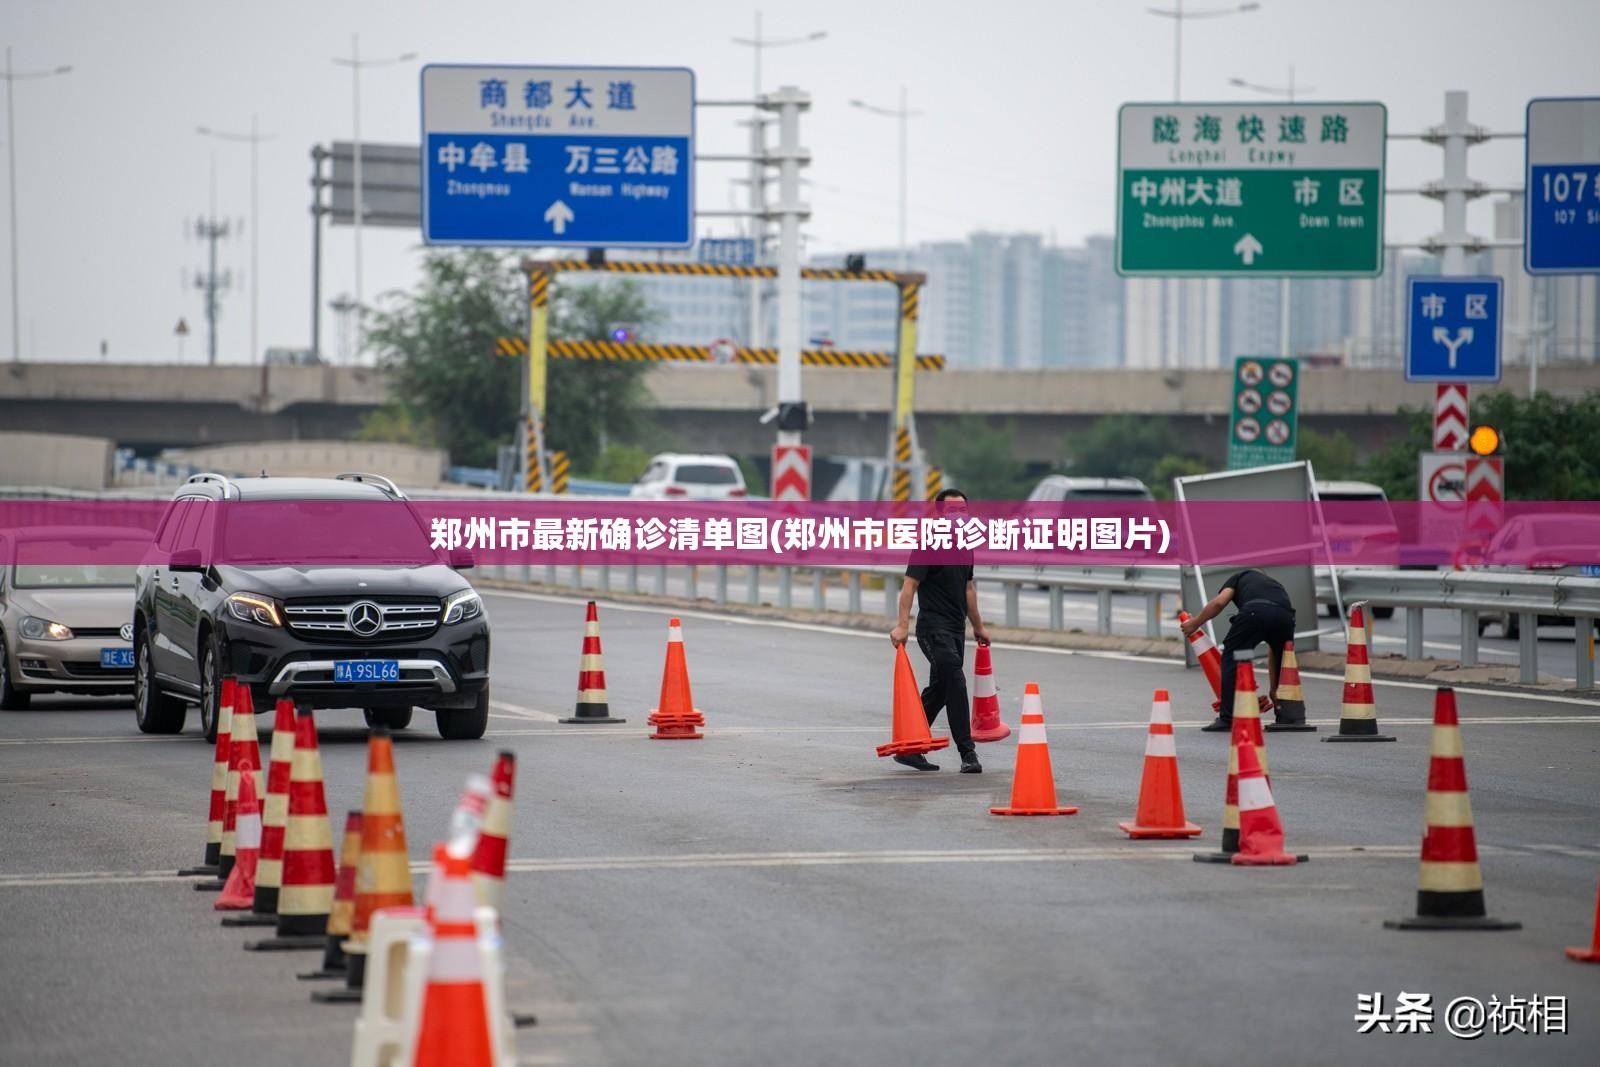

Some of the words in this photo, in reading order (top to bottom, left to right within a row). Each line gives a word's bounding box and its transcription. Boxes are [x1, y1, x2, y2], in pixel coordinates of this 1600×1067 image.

[479, 79, 636, 110] 商都大道
[1152, 114, 1349, 144] 陇海快速路
[438, 142, 531, 173] 中牟县
[565, 146, 678, 175] 万三公路
[1169, 148, 1226, 165] Longhai
[1131, 177, 1243, 207] 中州大道
[1542, 172, 1600, 202] 107
[1554, 209, 1576, 225] 107
